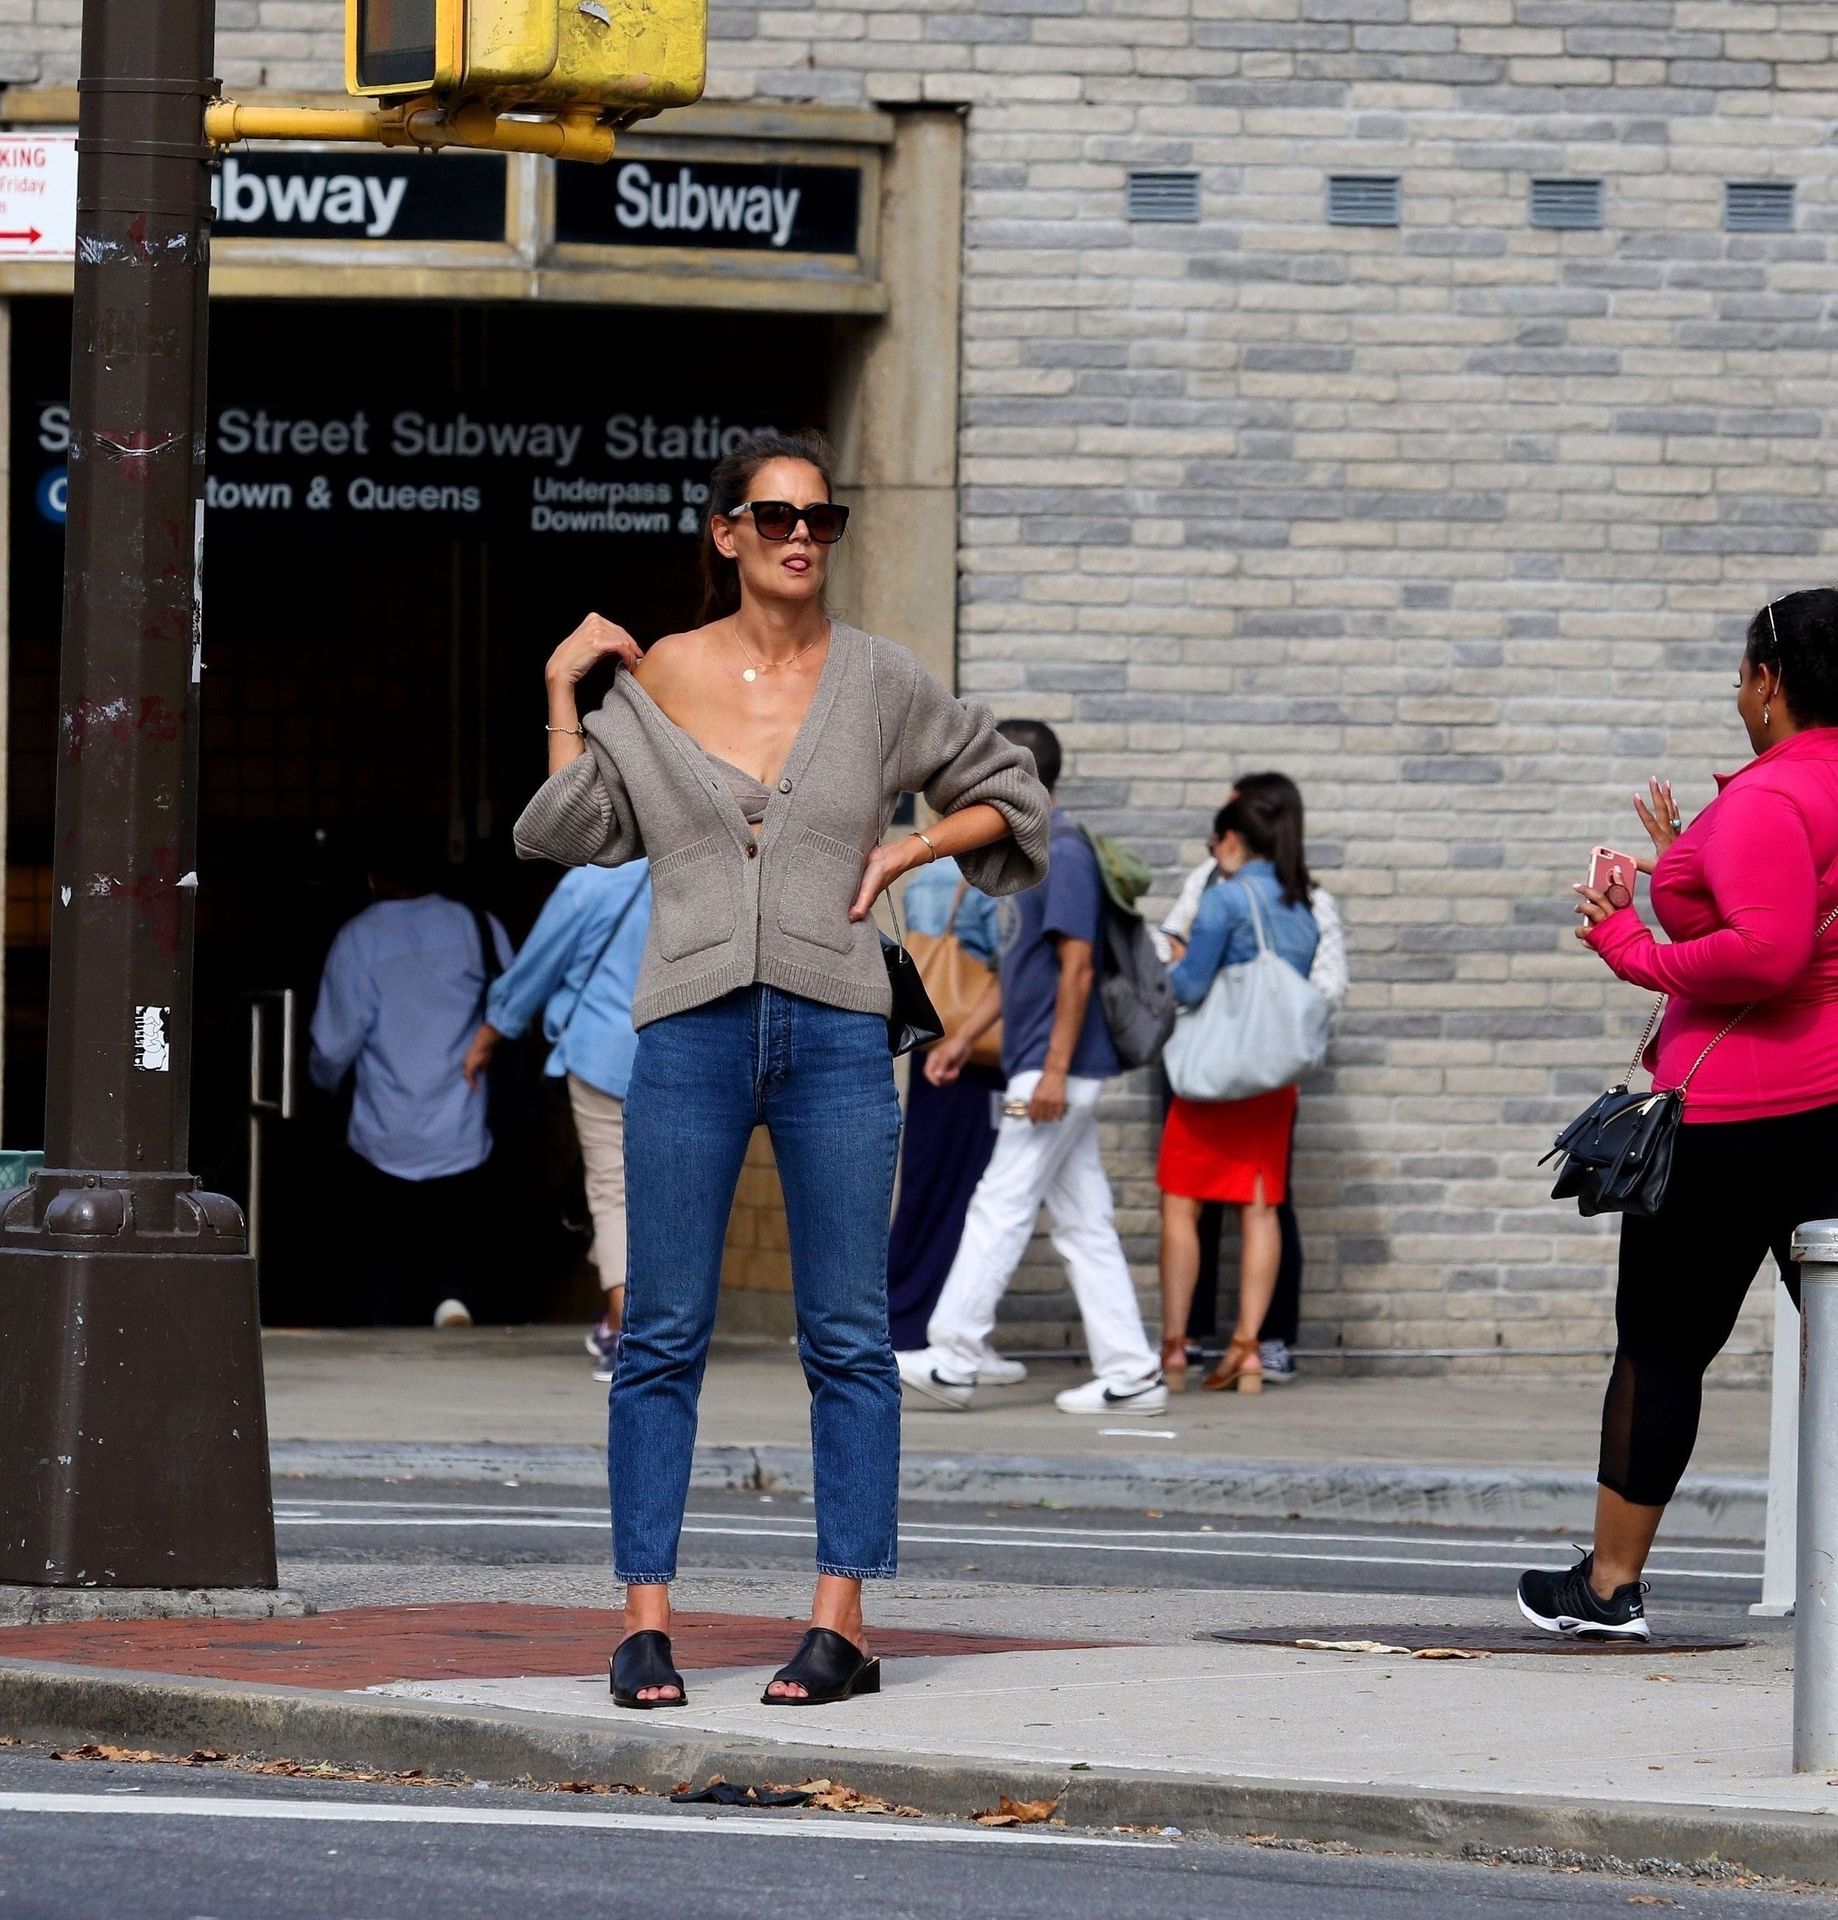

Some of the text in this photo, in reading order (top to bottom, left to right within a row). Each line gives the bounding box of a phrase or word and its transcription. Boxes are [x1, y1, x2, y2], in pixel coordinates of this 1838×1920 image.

[614, 162, 801, 247] Subway
[217, 408, 370, 454] Street
[391, 411, 583, 467] Subway
[305, 475, 332, 510] &
[347, 477, 482, 512] Queens
[533, 477, 709, 507] Underpass to
[531, 504, 700, 534] Downtown &
